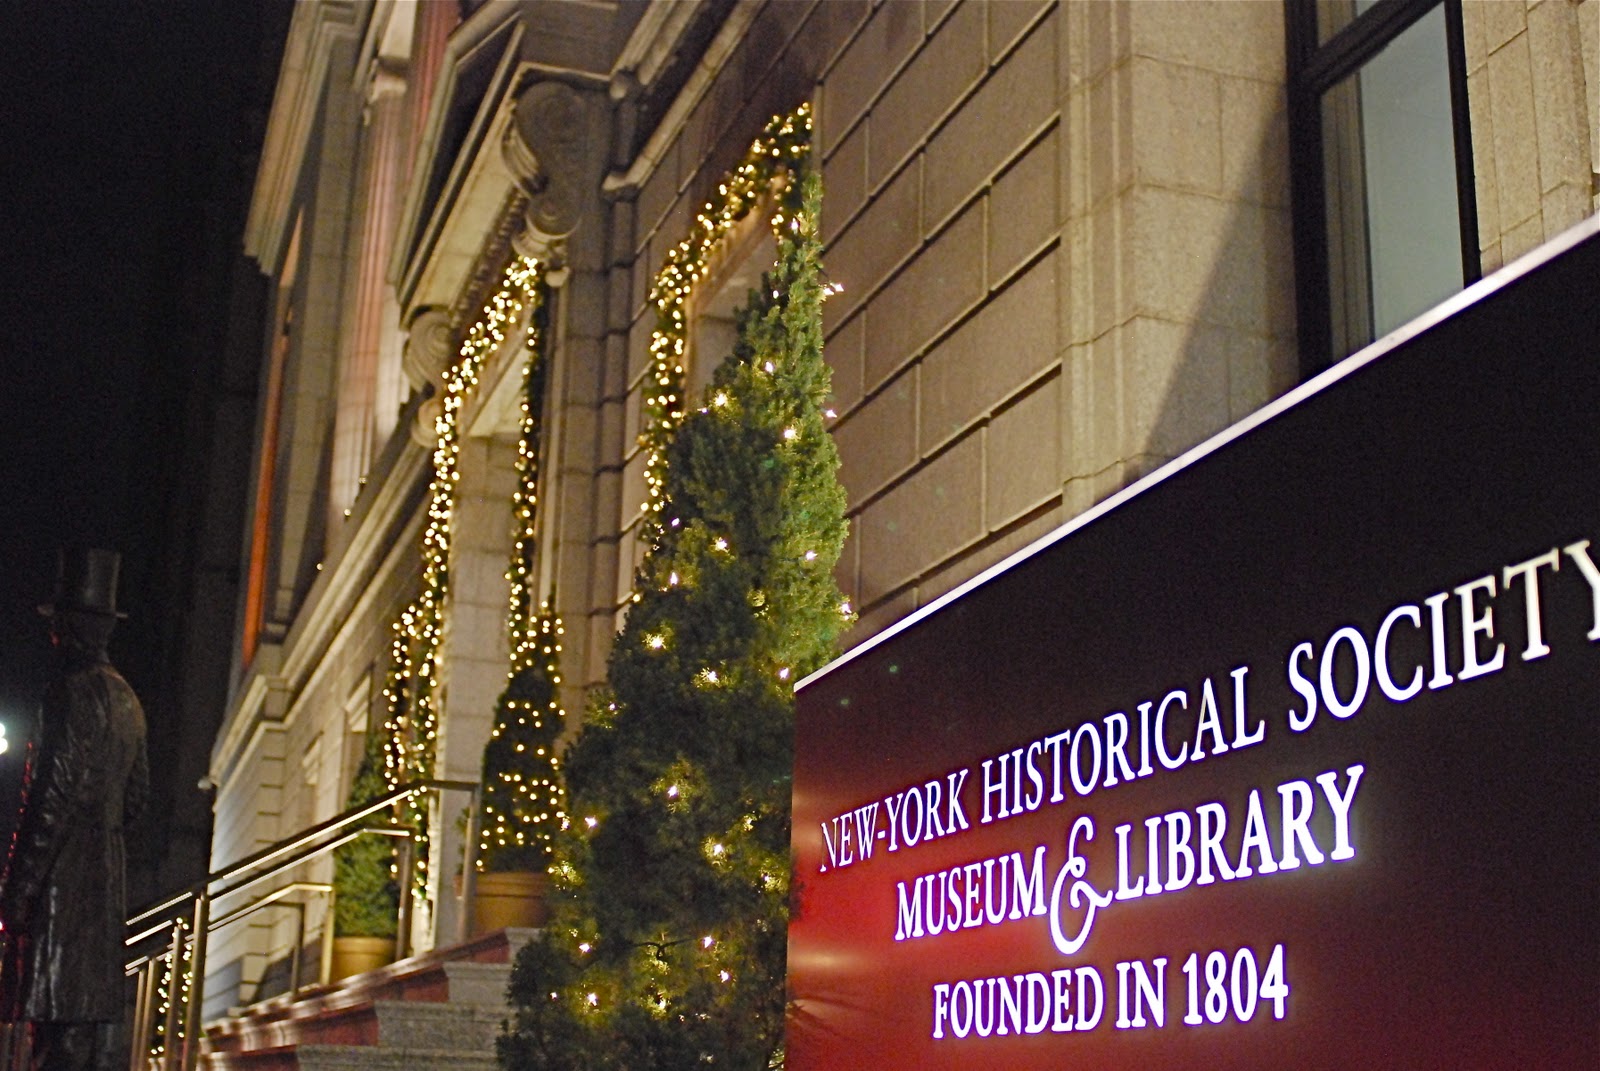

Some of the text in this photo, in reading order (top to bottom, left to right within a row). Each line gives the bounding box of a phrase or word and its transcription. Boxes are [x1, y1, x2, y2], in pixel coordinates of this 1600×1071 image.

[820, 540, 1600, 873] NEW-YORK HISTORICAL SOCIETY
[895, 764, 1364, 955] MUSEUM & LIBRARY
[932, 944, 1289, 1040] FOUNDED IN 1804
